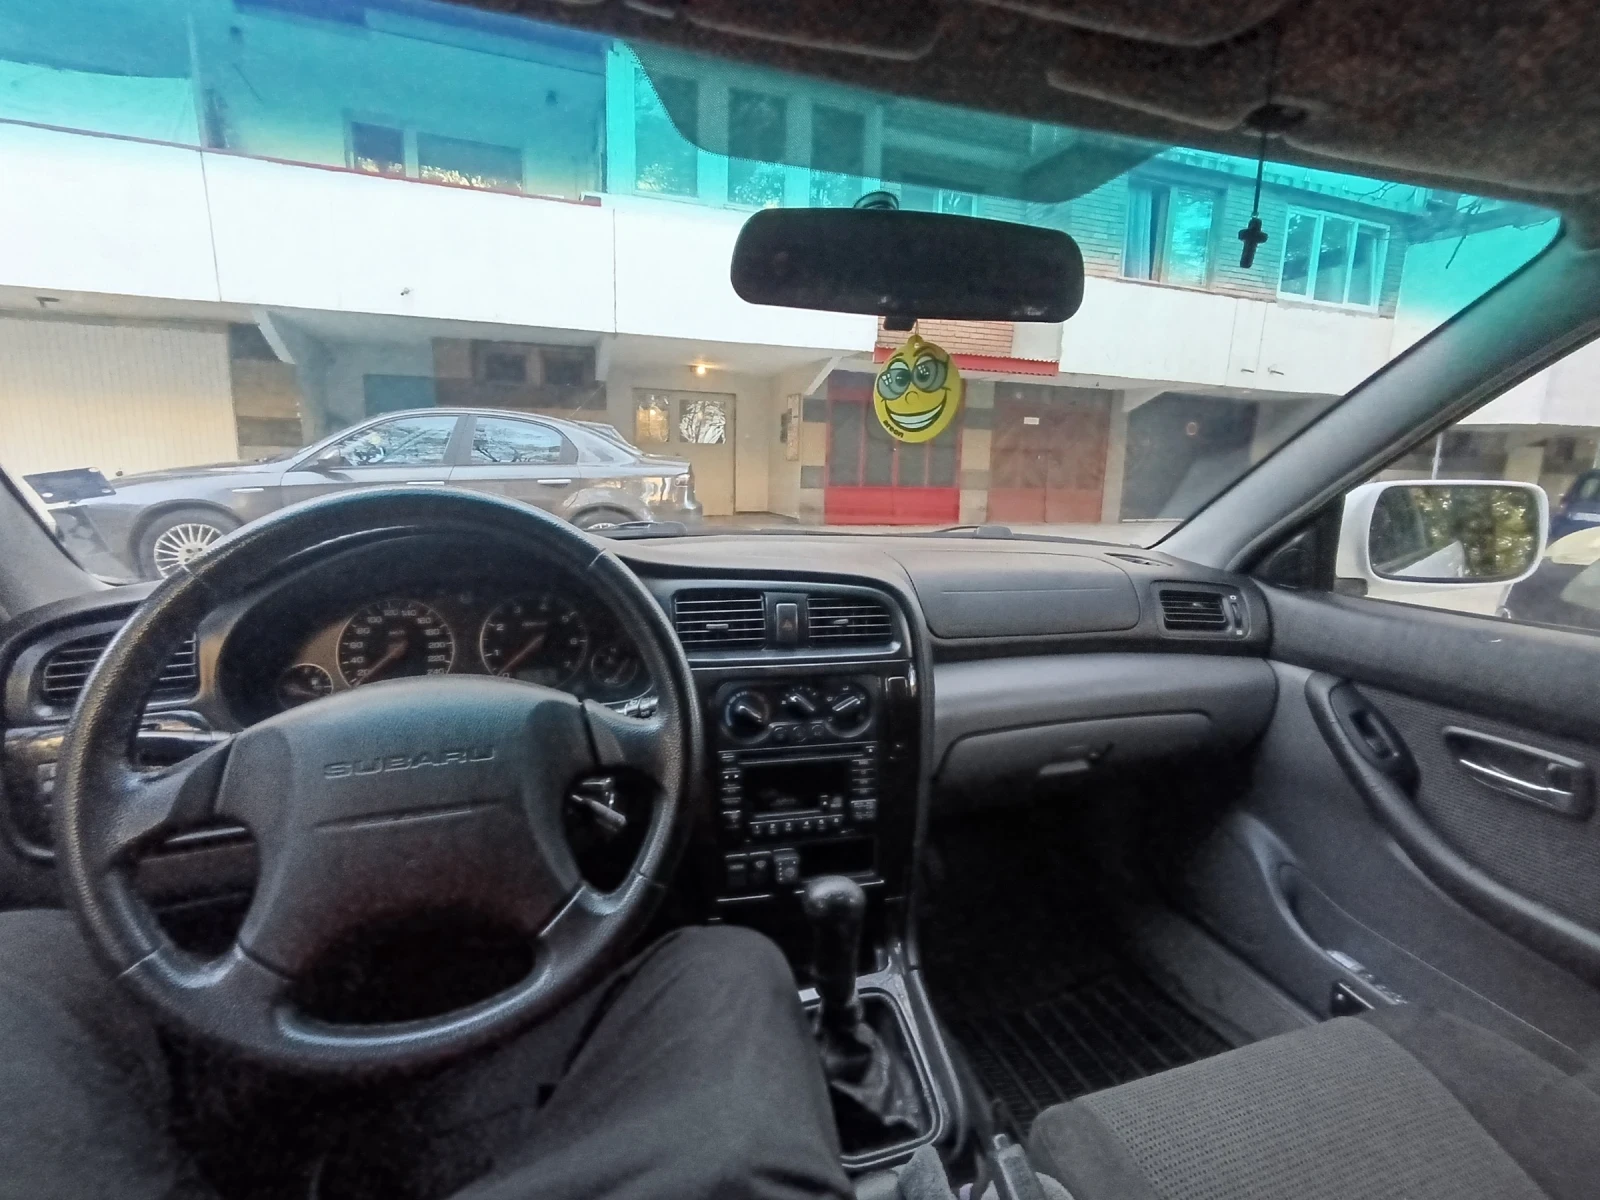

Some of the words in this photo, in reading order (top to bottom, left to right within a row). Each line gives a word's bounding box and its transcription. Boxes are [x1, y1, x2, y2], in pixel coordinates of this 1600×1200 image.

[883, 420, 904, 438] areon
[367, 616, 382, 624] 100
[496, 623, 504, 631] 2
[357, 669, 369, 677] 20
[323, 747, 496, 779] SUBARU
